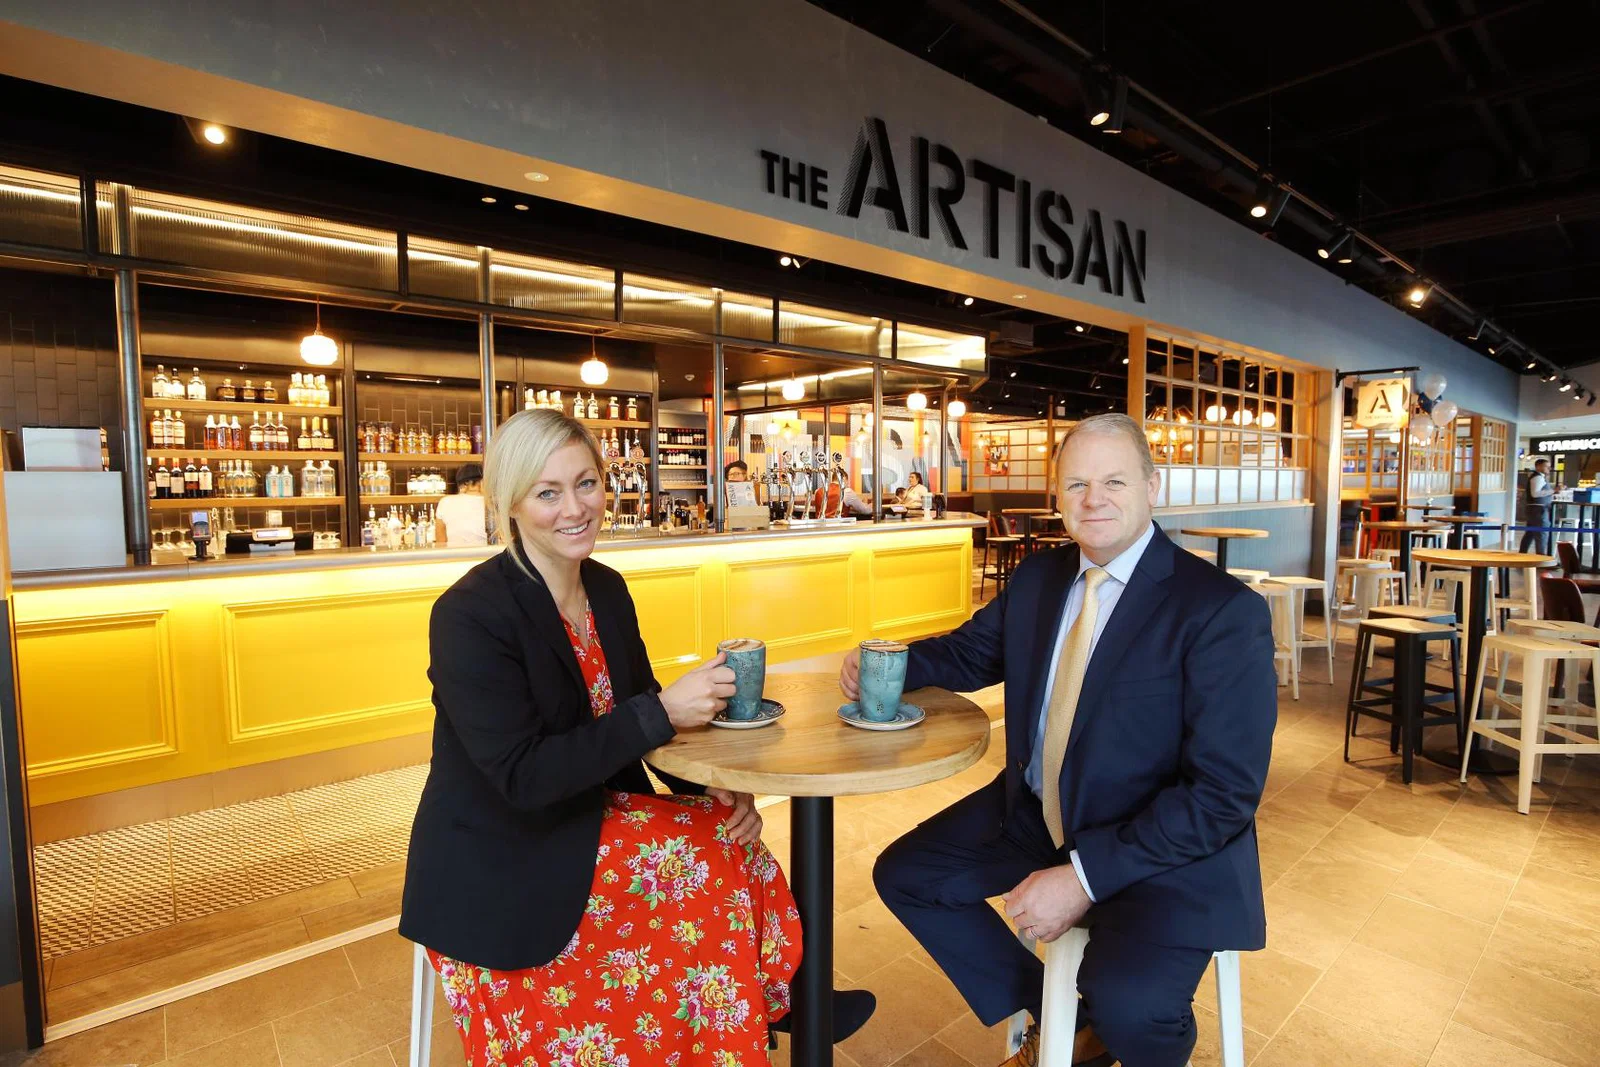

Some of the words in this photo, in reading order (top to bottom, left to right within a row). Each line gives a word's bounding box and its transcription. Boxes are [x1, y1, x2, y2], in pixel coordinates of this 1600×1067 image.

[758, 149, 828, 210] THE
[837, 116, 1146, 304] ARTISAN
[1370, 389, 1391, 413] A
